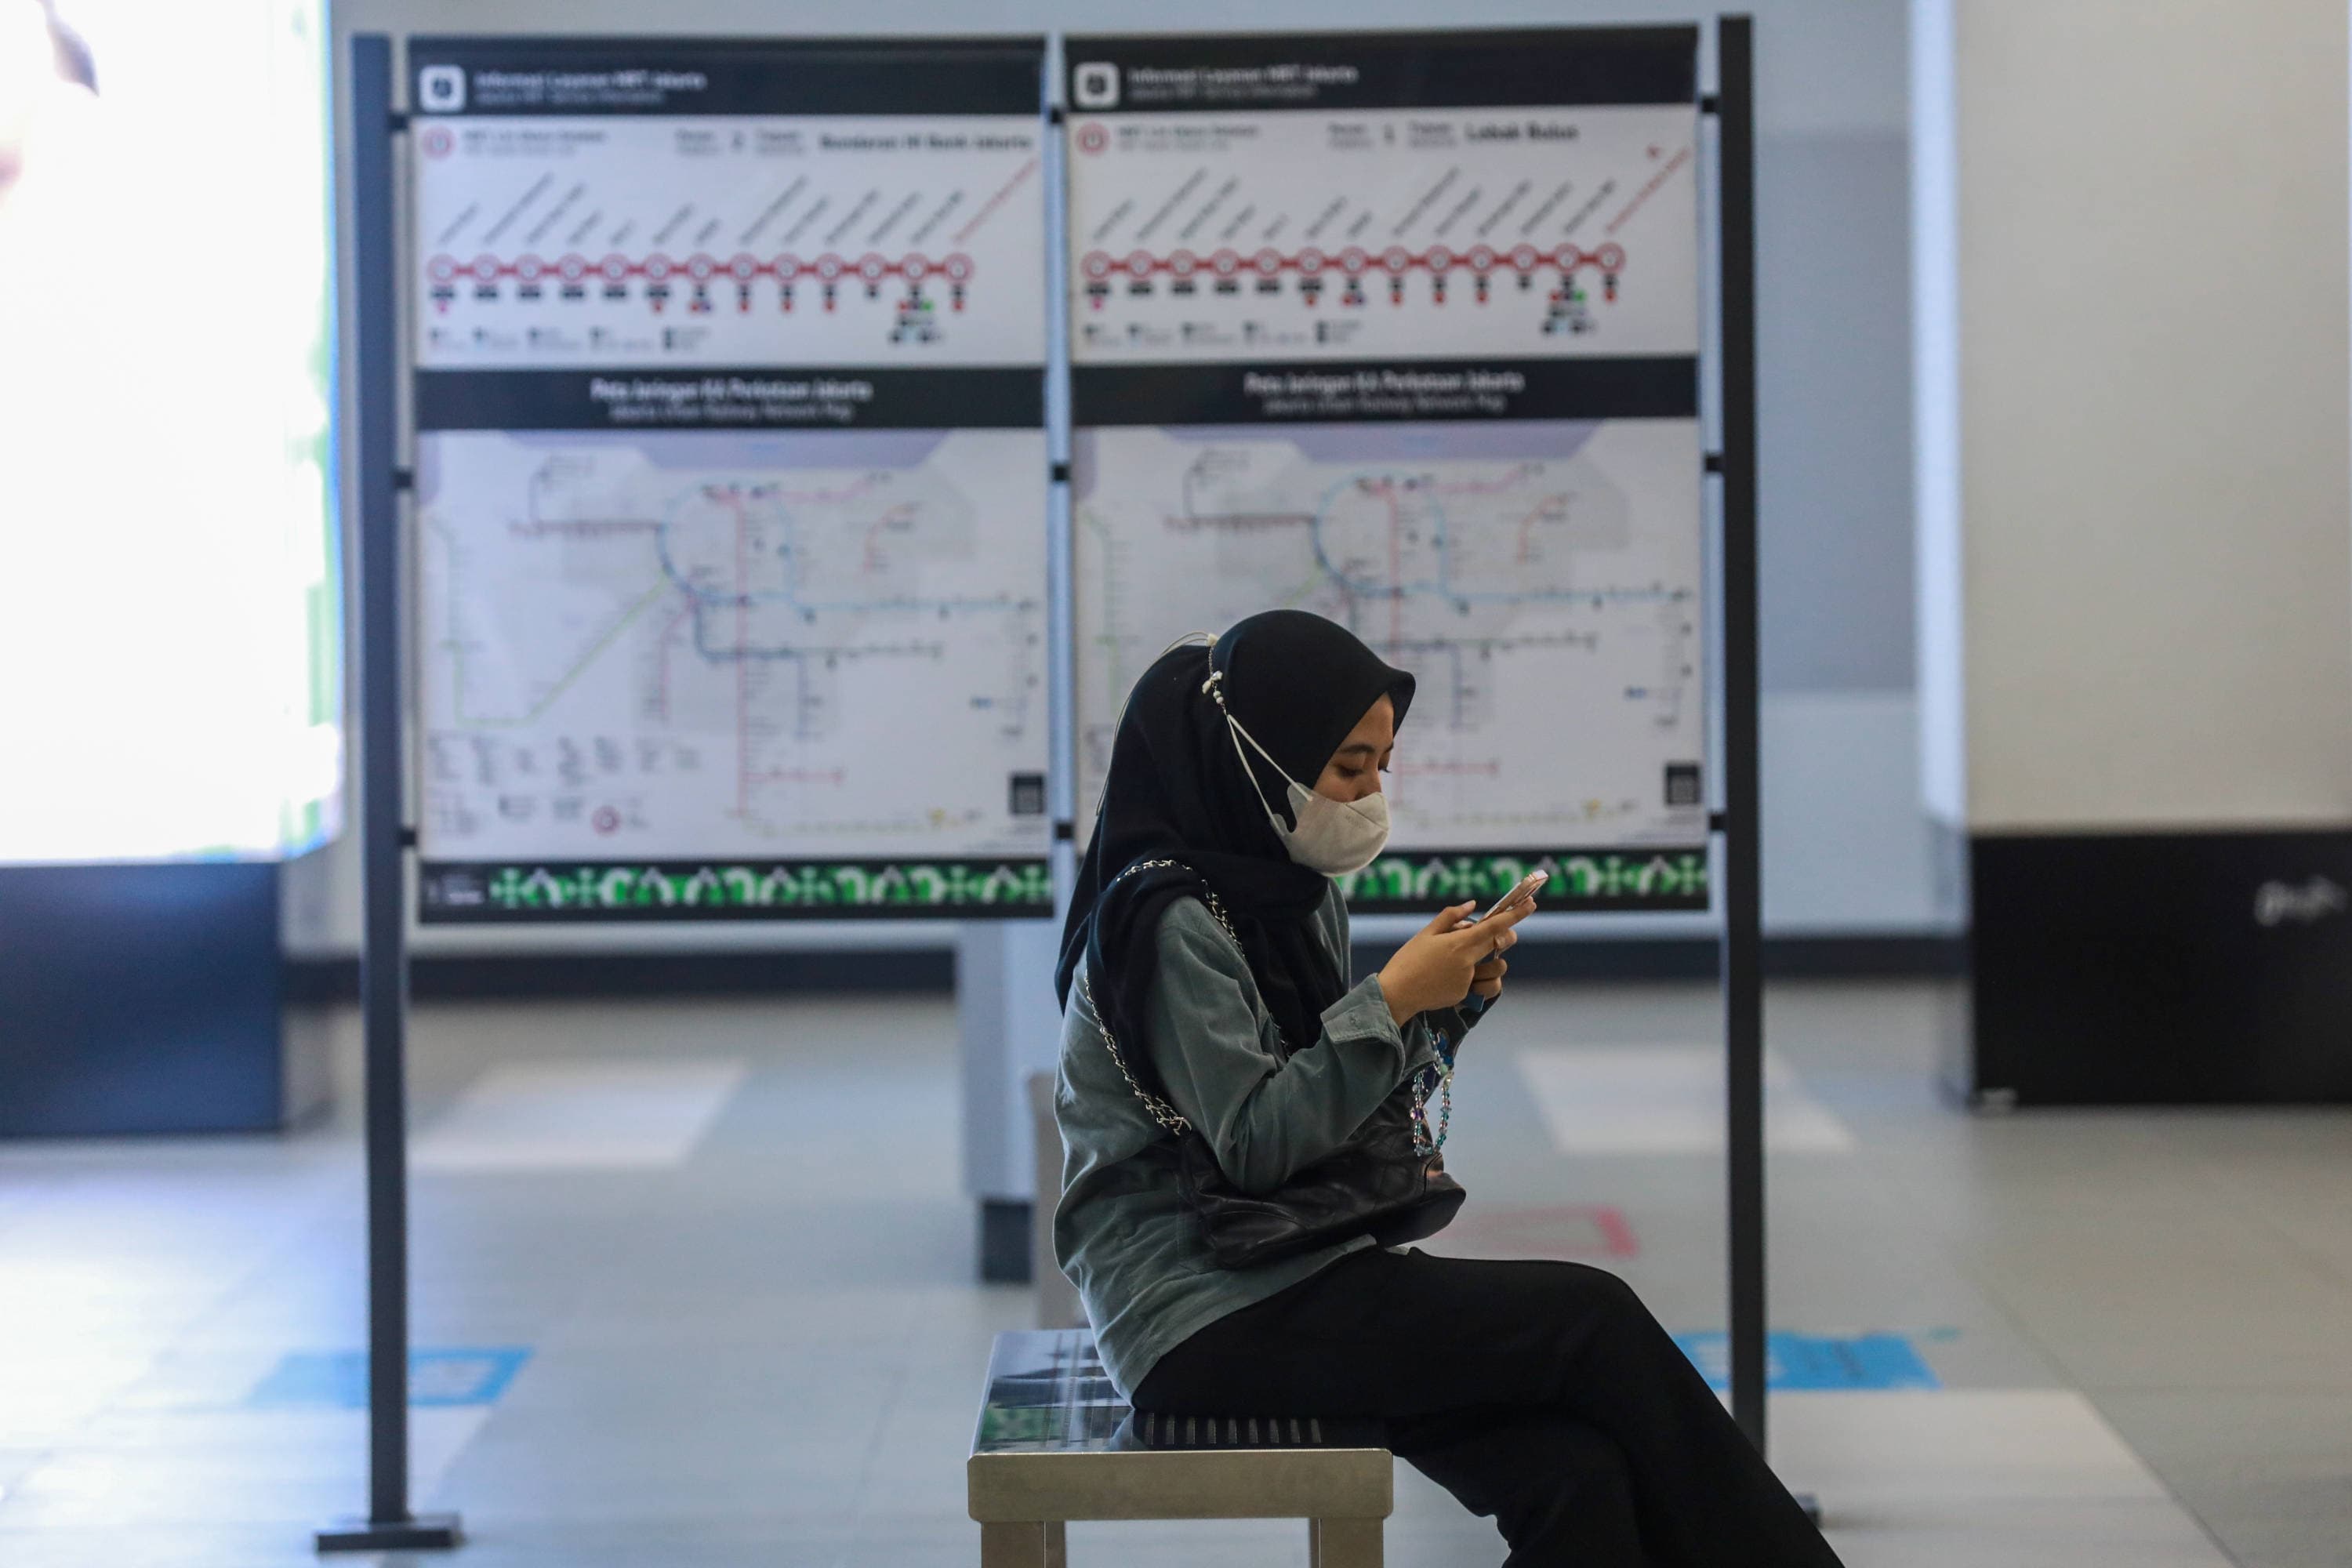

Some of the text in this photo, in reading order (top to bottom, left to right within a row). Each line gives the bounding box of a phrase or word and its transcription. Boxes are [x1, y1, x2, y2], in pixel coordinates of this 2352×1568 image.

[652, 72, 705, 89] Jakarta
[1303, 66, 1356, 82] Jakarta
[1465, 123, 1522, 143] Lebak
[1525, 122, 1577, 142] Bulus
[818, 134, 899, 152] Bundaran
[926, 134, 968, 151] Bank
[972, 134, 1033, 151] Jakarta
[591, 380, 630, 400] Peta
[631, 379, 701, 403] Jaringan
[729, 379, 811, 400] Perkotaan
[814, 379, 871, 400] Jakarta
[1245, 372, 1283, 394] Peta
[1285, 372, 1352, 396] Jaringan
[1381, 371, 1462, 393] Perkotaan
[1465, 370, 1523, 392] Jakarta
